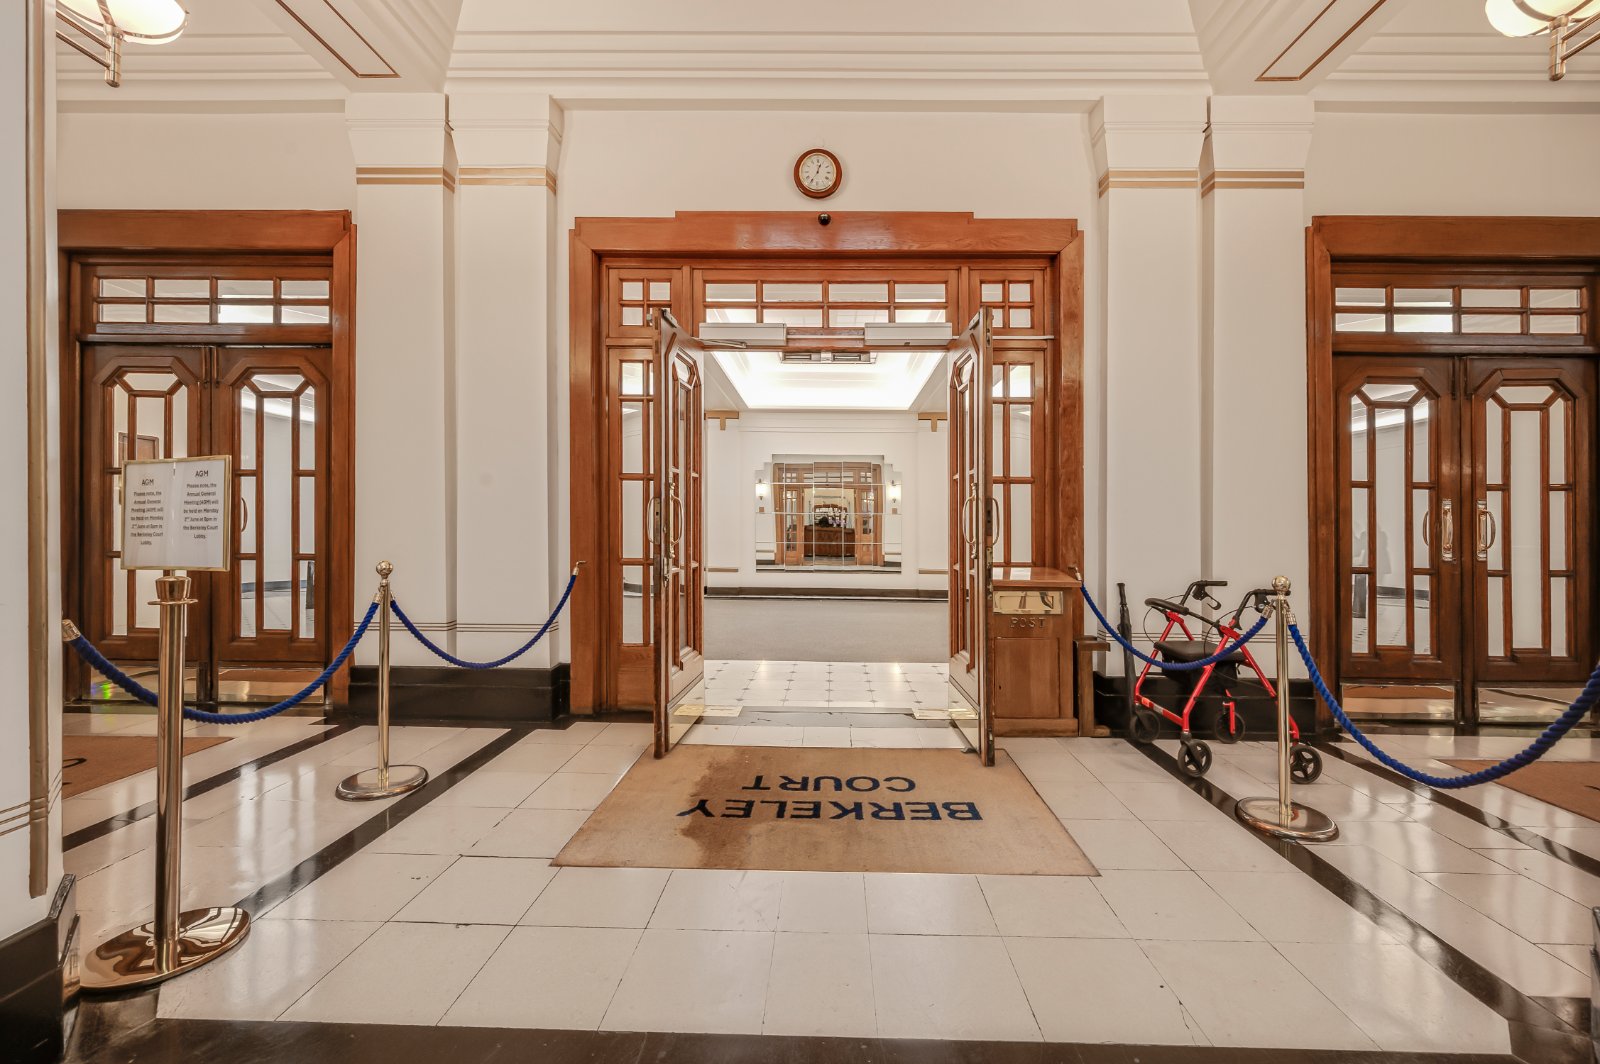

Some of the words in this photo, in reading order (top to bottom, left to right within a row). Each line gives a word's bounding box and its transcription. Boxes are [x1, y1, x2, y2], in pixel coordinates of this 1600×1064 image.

[1010, 617, 1046, 628] POST
[742, 775, 916, 792] COURT
[676, 798, 983, 821] BERKELEY
